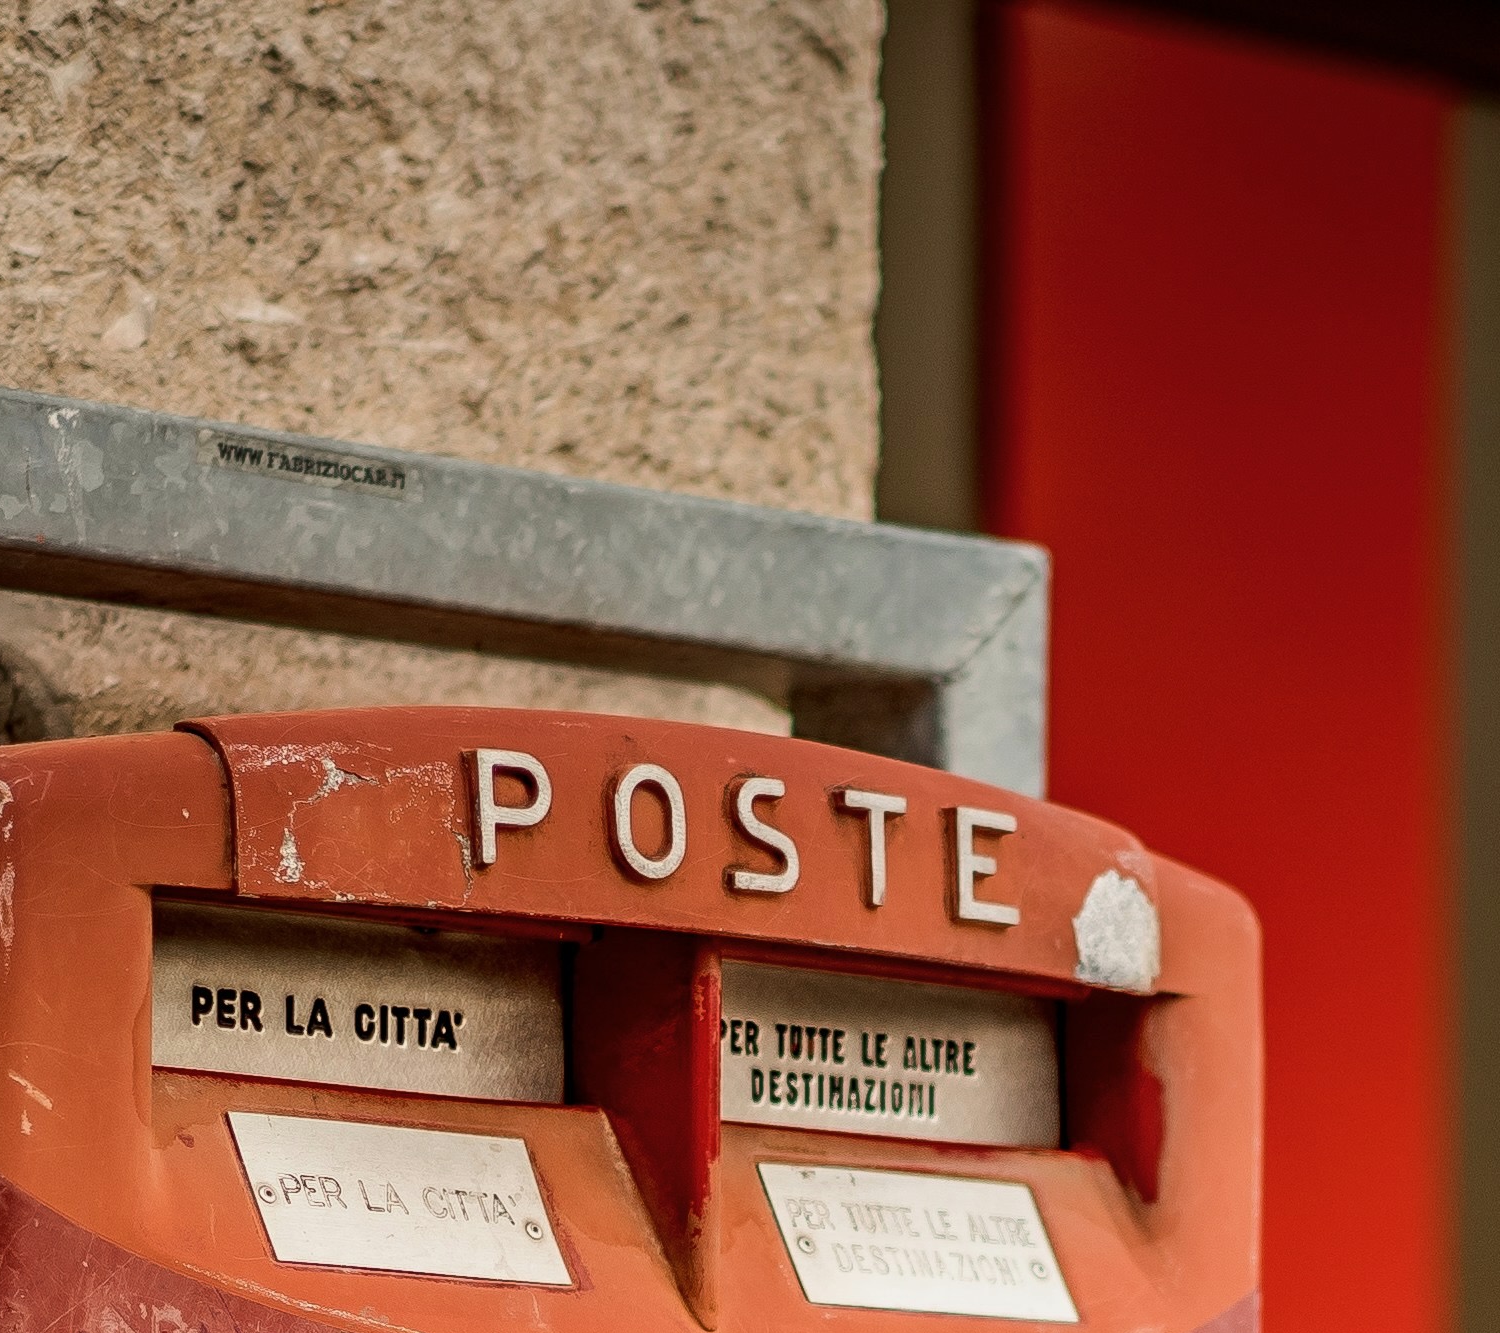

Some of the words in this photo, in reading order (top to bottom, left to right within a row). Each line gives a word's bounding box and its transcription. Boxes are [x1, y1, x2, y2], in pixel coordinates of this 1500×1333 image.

[466, 747, 1021, 926] POSTE
[191, 984, 263, 1032] PER
[285, 994, 333, 1038] LA
[354, 1002, 464, 1051] CITTA'
[775, 1023, 846, 1065] TUTTE
[861, 1031, 889, 1068] LE
[902, 1035, 978, 1077] ALTRE
[750, 1067, 937, 1119] DESTINAZIONI
[278, 1173, 348, 1210] PER
[357, 1179, 410, 1216] LA
[421, 1185, 519, 1226] CITTA'
[786, 1198, 836, 1231] PER
[841, 1202, 920, 1240] TUTTE
[924, 1209, 958, 1242] LE
[967, 1212, 1038, 1248] ALTRE
